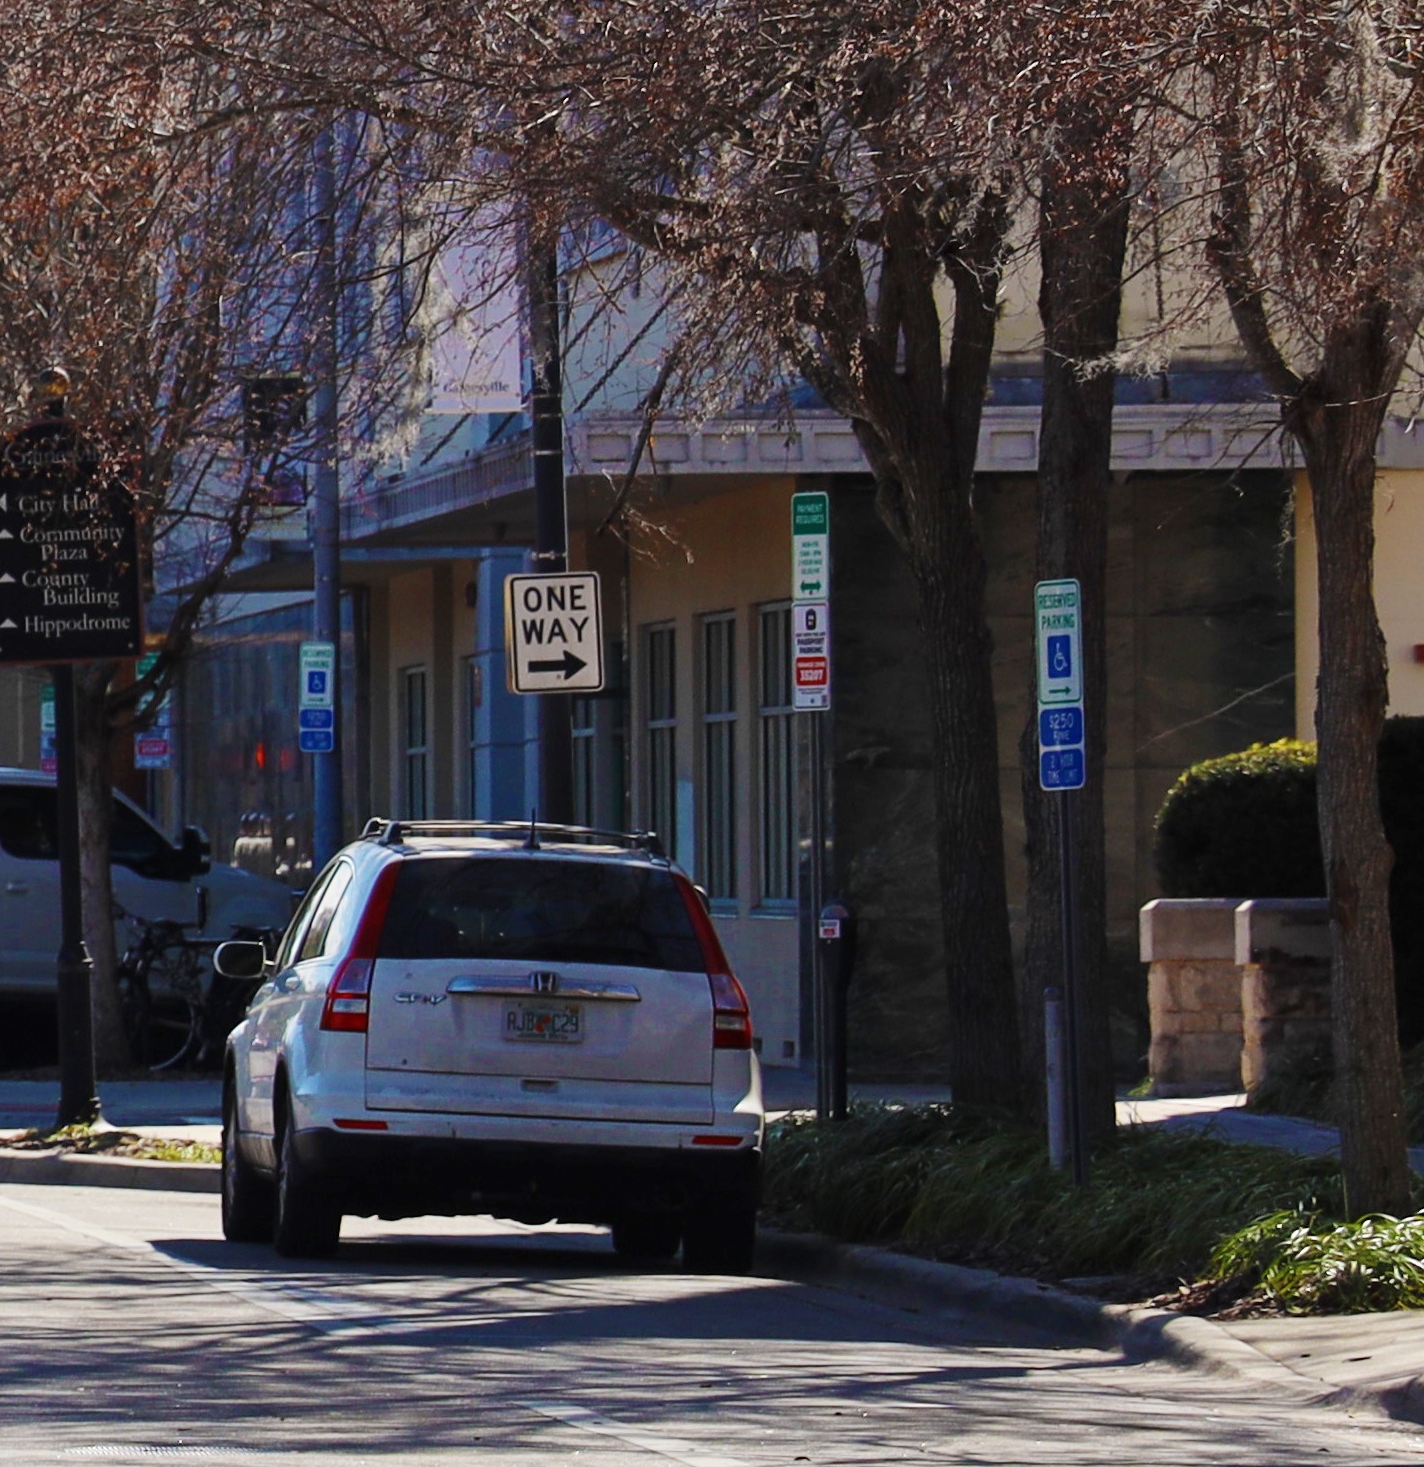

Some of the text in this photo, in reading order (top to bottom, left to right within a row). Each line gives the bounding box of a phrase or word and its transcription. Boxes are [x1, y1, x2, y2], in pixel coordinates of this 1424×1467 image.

[18, 493, 100, 514] City Hall
[796, 503, 824, 514] PAYMENT
[795, 514, 825, 524] REQUIRED
[19, 525, 126, 544] Community
[41, 545, 88, 560] Plaza
[22, 569, 90, 587] County
[43, 586, 120, 607] Building
[523, 585, 587, 613] ONE
[1038, 592, 1077, 610] RESERVED
[25, 613, 130, 637] Hippodrome
[1041, 613, 1076, 630] PARKING
[521, 616, 590, 646] WAY
[1049, 713, 1074, 729] $250
